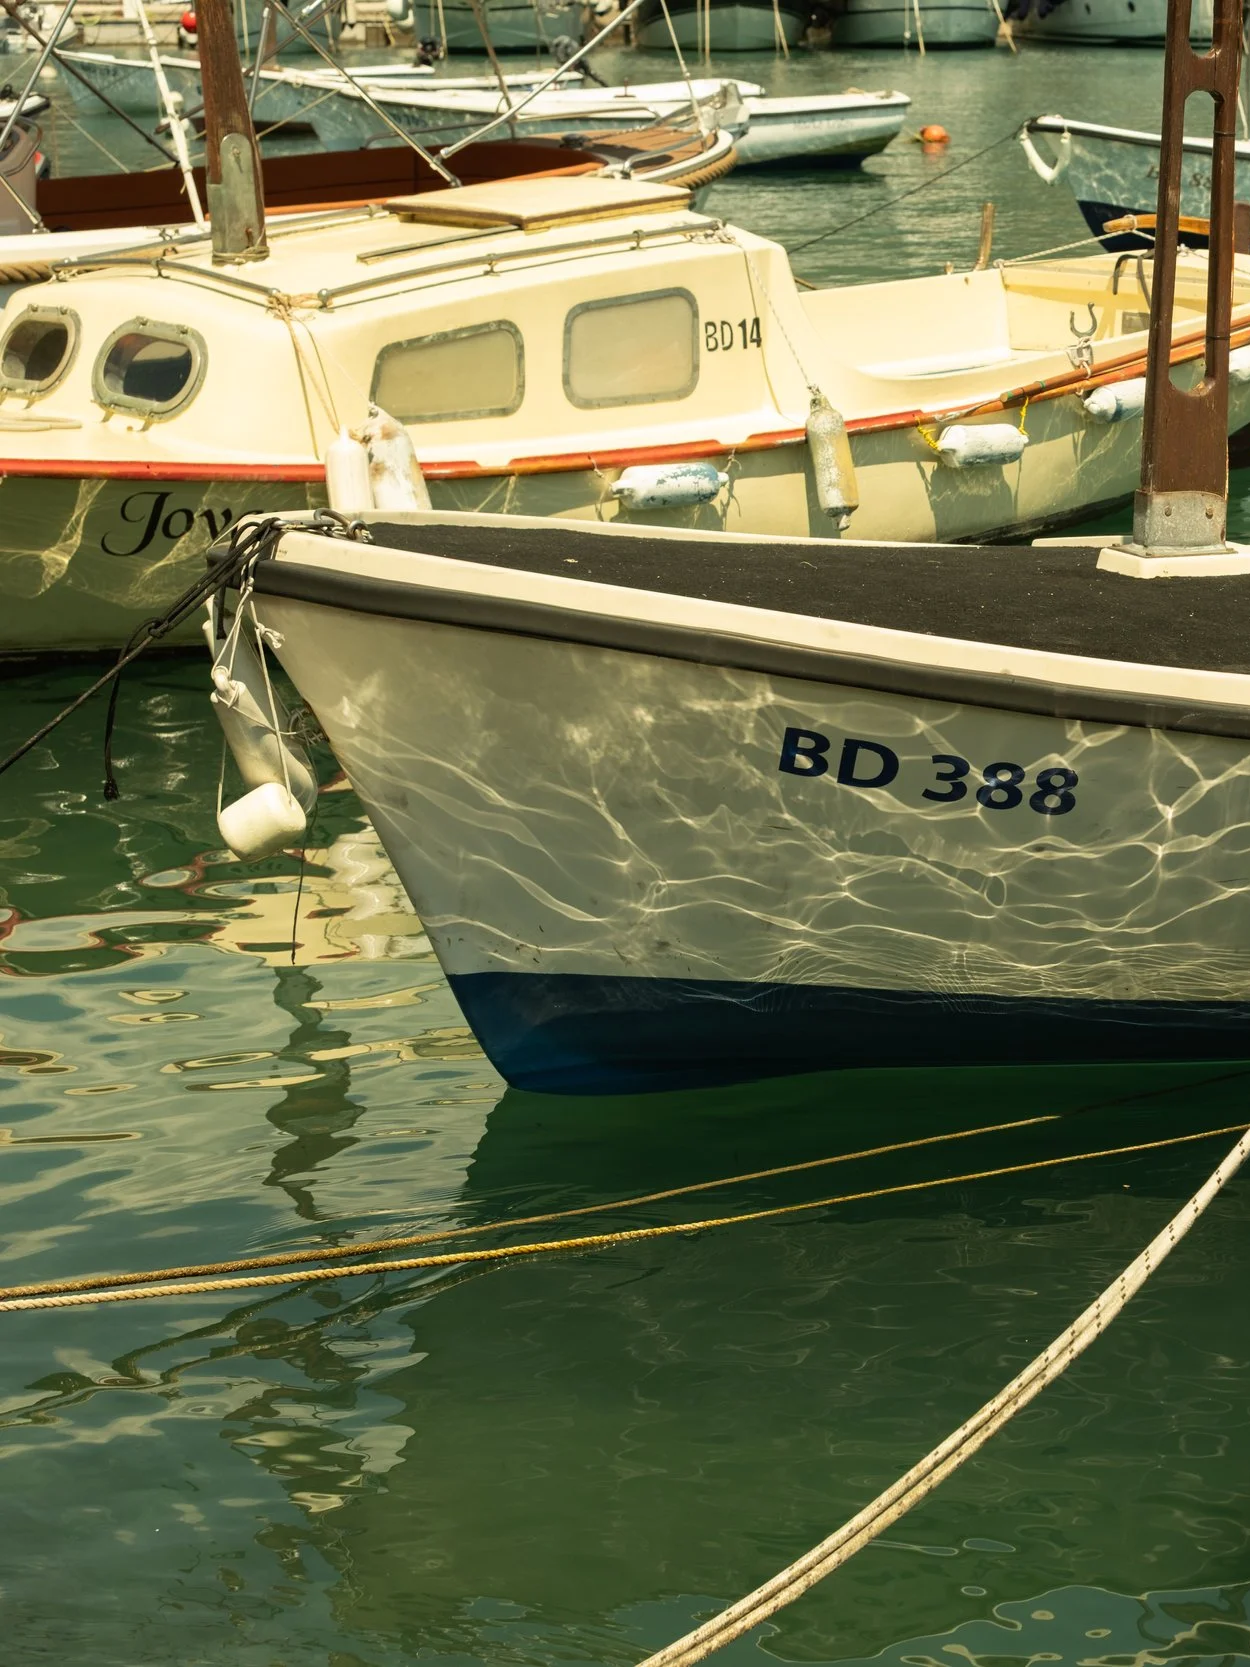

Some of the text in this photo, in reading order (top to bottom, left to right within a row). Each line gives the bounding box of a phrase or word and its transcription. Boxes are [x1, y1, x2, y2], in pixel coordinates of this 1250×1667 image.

[704, 316, 762, 352] BD 14
[100, 491, 265, 557] Jov
[778, 726, 1079, 816] BD 388
